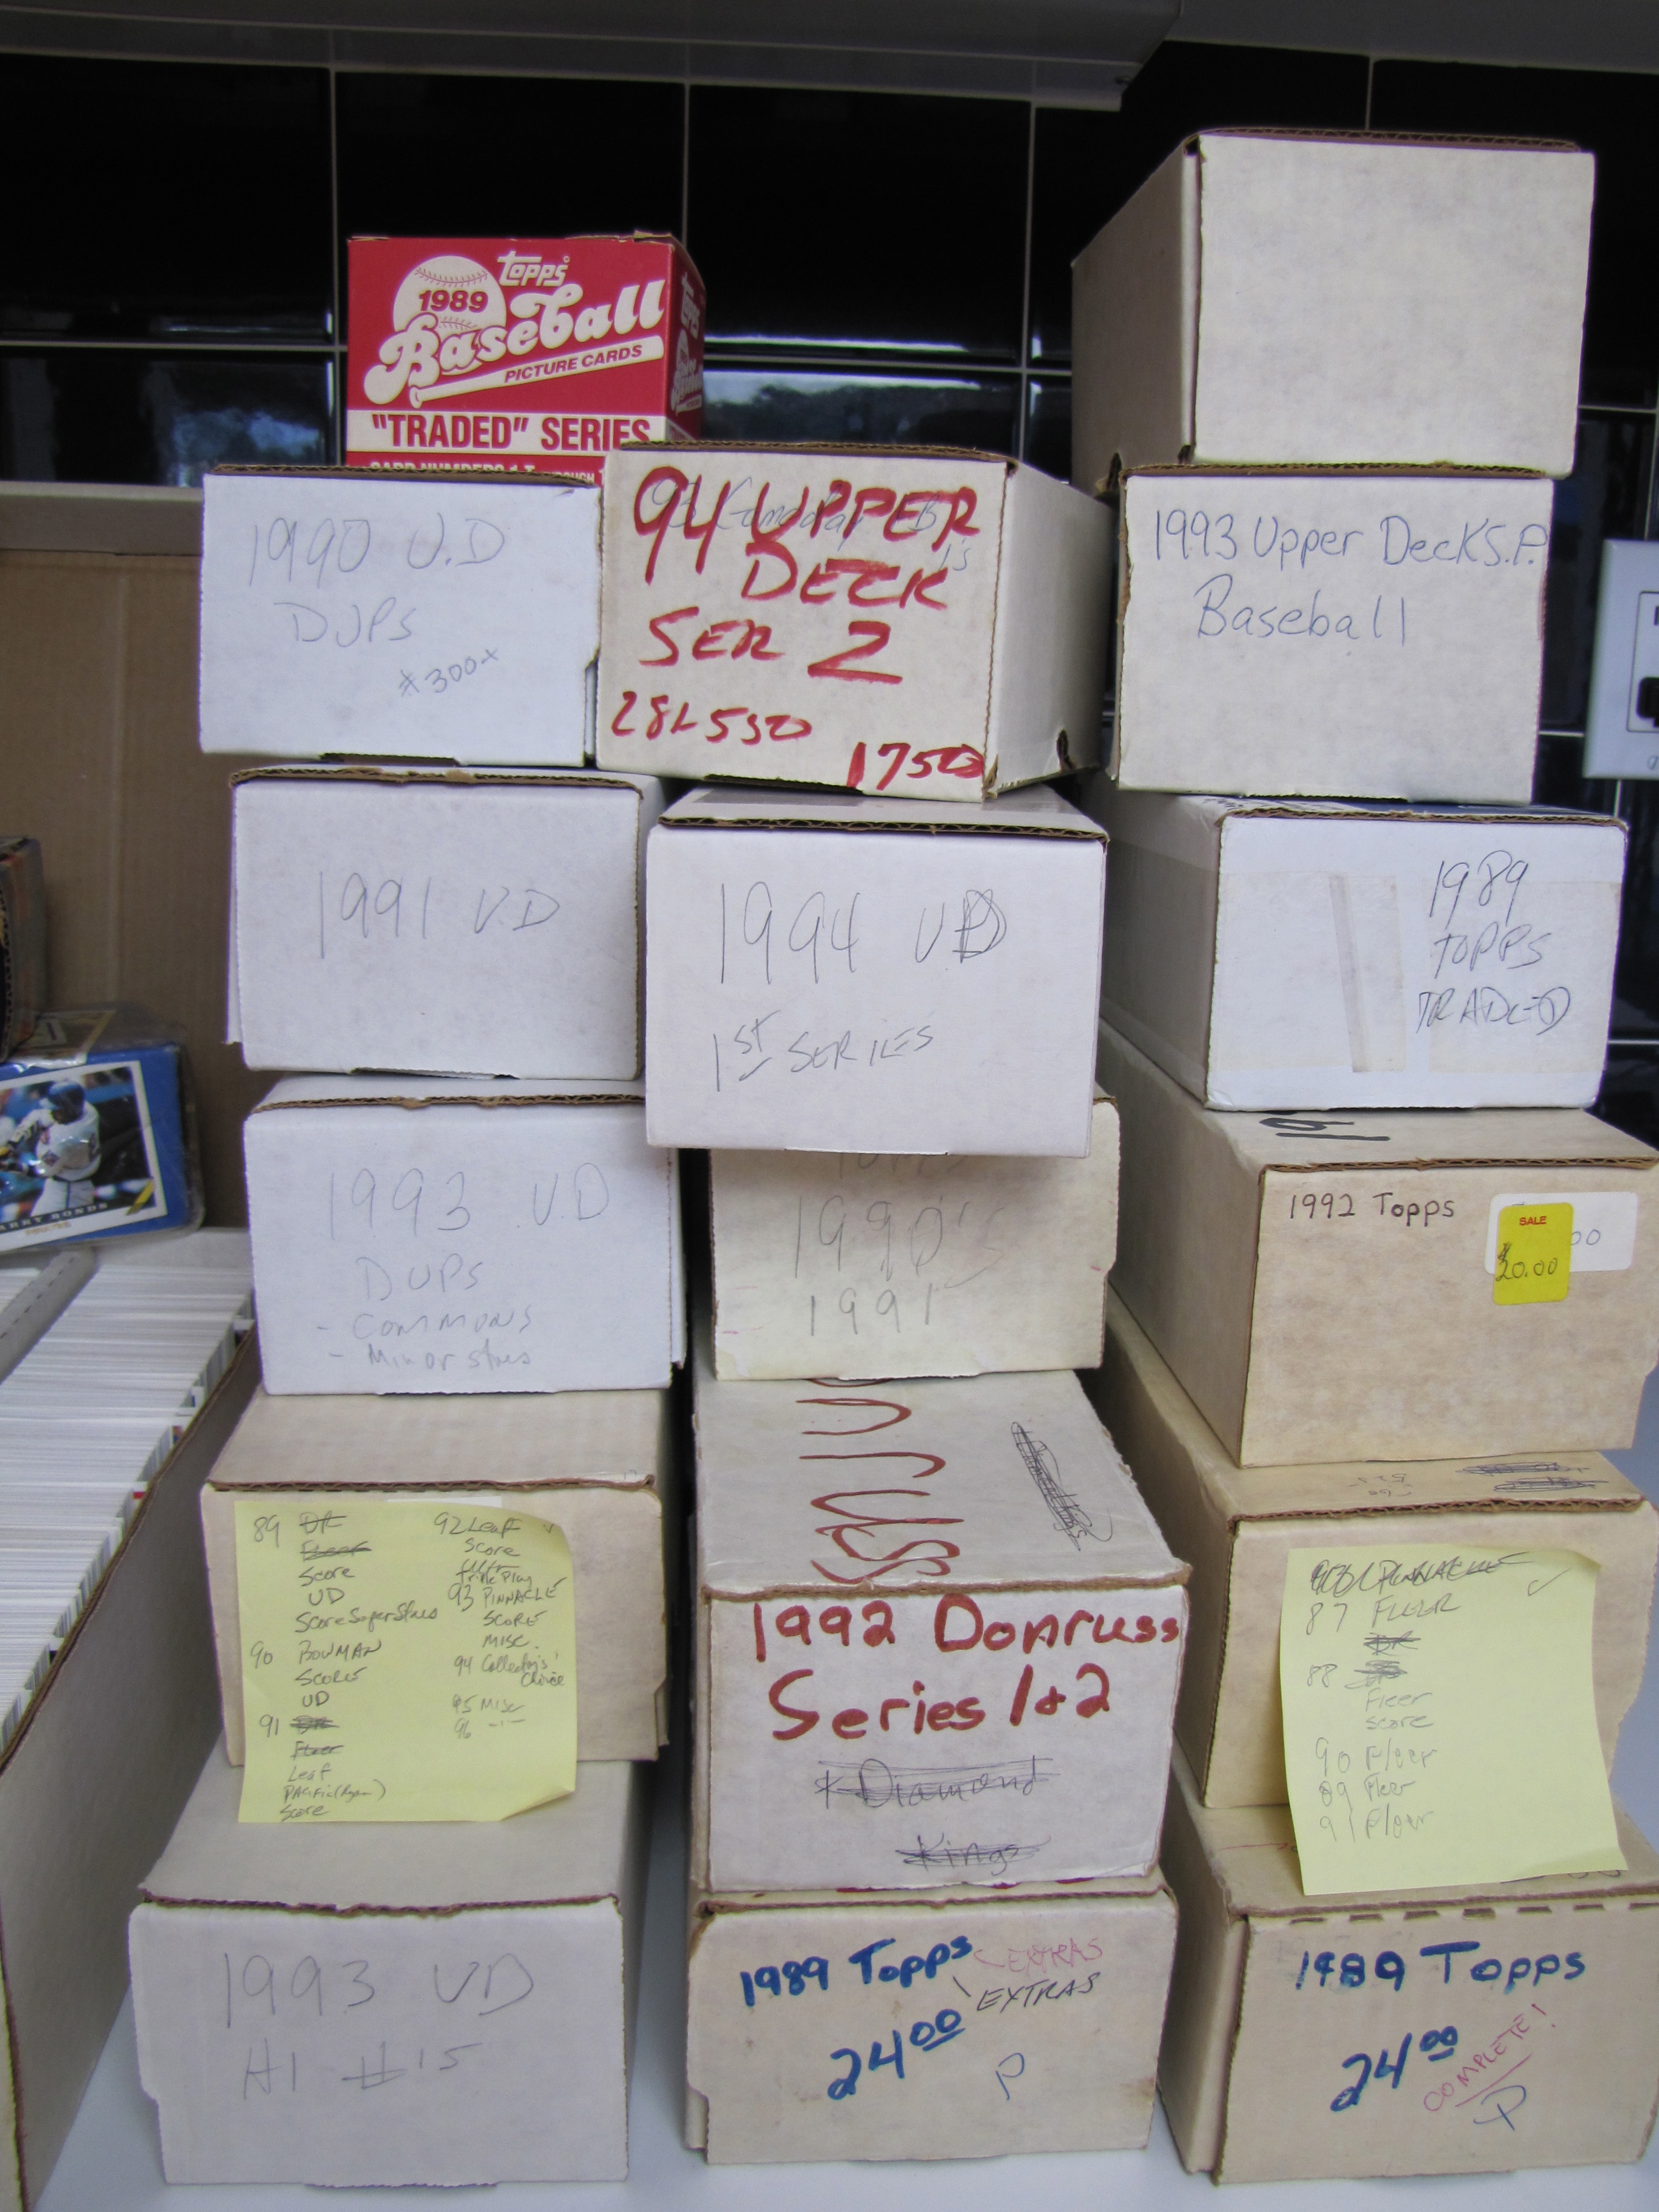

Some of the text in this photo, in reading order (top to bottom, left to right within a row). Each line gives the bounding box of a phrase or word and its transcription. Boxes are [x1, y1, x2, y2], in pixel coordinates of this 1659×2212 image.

[418, 290, 488, 312] 1989
[364, 280, 665, 404] Baseball
[504, 345, 642, 383] PICTURE CARDS
[541, 417, 651, 451] SERIES
[634, 466, 981, 586] 94 UPPER
[1156, 509, 1238, 560] 1993
[1253, 515, 1364, 572] Upper
[249, 517, 371, 589] 1990
[740, 542, 948, 611] DECK
[274, 597, 417, 648] DUPS
[1193, 573, 1407, 646] Baseball
[806, 620, 903, 684] 2
[320, 869, 432, 959] 1991
[1429, 849, 1530, 930] 1989
[719, 880, 860, 985] 1994
[331, 1162, 609, 1241] 1993 UD
[1288, 1191, 1455, 1228] 1992 Topps
[1519, 1215, 1547, 1226] SALE
[355, 1253, 484, 1301] DUPS
[810, 1282, 933, 1337] 1991
[254, 1514, 280, 1548] 89
[435, 1511, 466, 1535] 92
[309, 1587, 345, 1606] UD
[448, 1582, 474, 1613] 93
[1306, 1602, 1348, 1635] 87
[753, 1593, 1180, 1662] 1992 Donruss
[251, 1640, 274, 1669] 90
[453, 1655, 473, 1677] 94
[1306, 1663, 1338, 1688] 88
[302, 1690, 330, 1708] UD
[769, 1669, 987, 1741] Series
[259, 1714, 280, 1738] 91
[223, 1952, 534, 2029] 1993 UD
[740, 1936, 974, 2007] 1989 Topps
[975, 1971, 1102, 2014] EXTRAS
[1295, 1940, 1586, 1994] 1989 Topps
